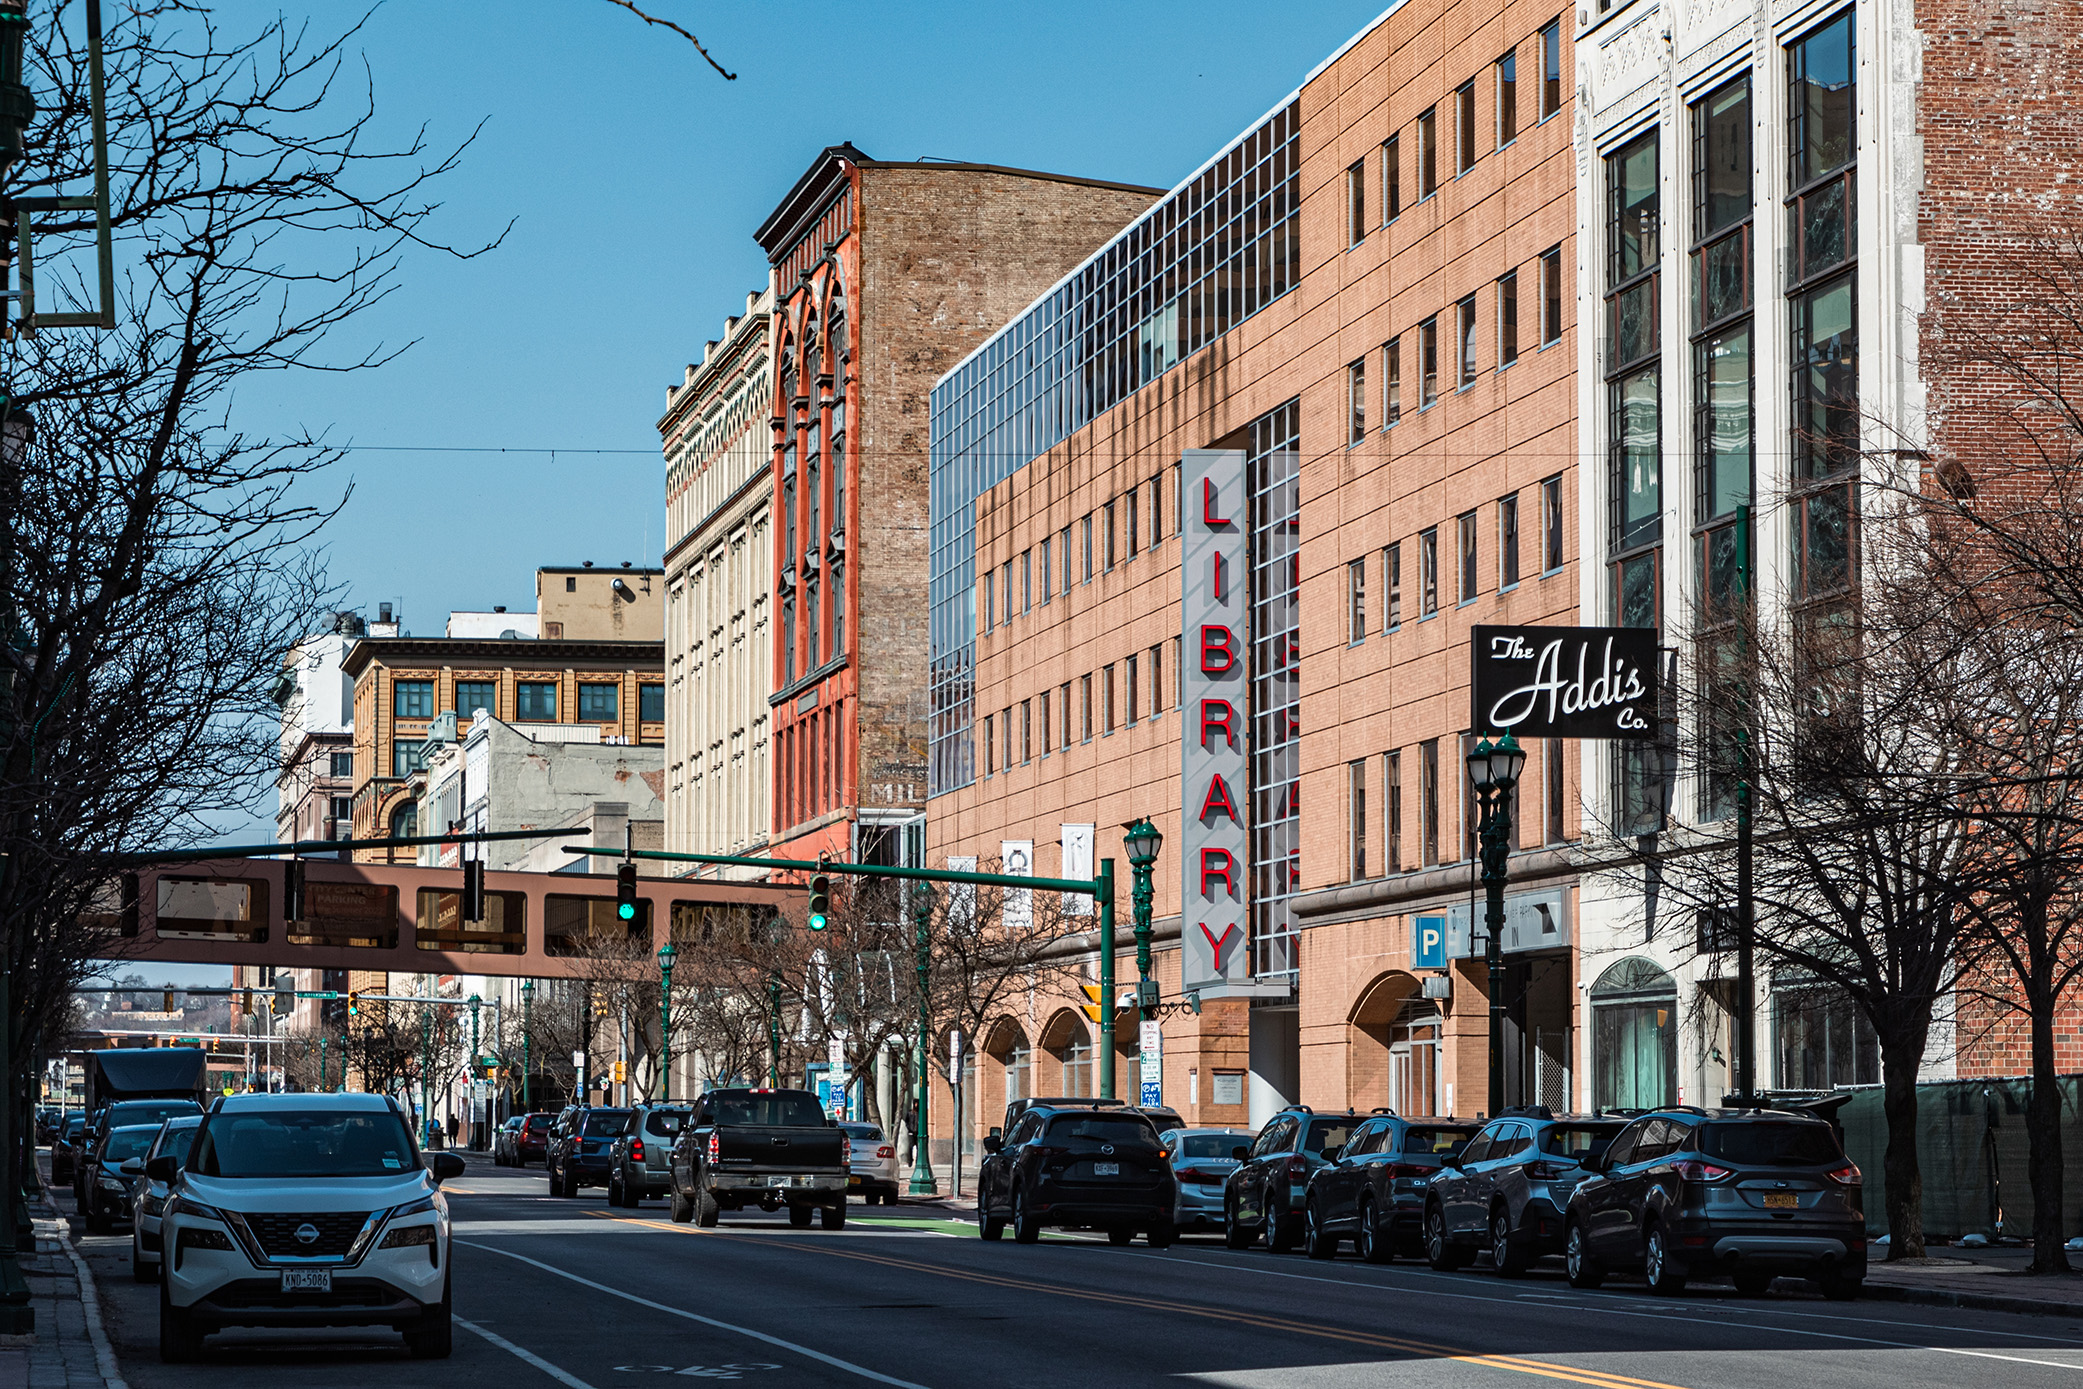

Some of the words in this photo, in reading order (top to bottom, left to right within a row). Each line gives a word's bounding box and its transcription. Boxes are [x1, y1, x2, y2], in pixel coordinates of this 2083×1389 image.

[1491, 635, 1535, 659] The
[1489, 635, 1646, 728] Addis
[1199, 476, 1236, 970] LIBRARY
[1616, 706, 1648, 729] Co.
[317, 894, 367, 905] PARKING
[1422, 928, 1440, 956] P
